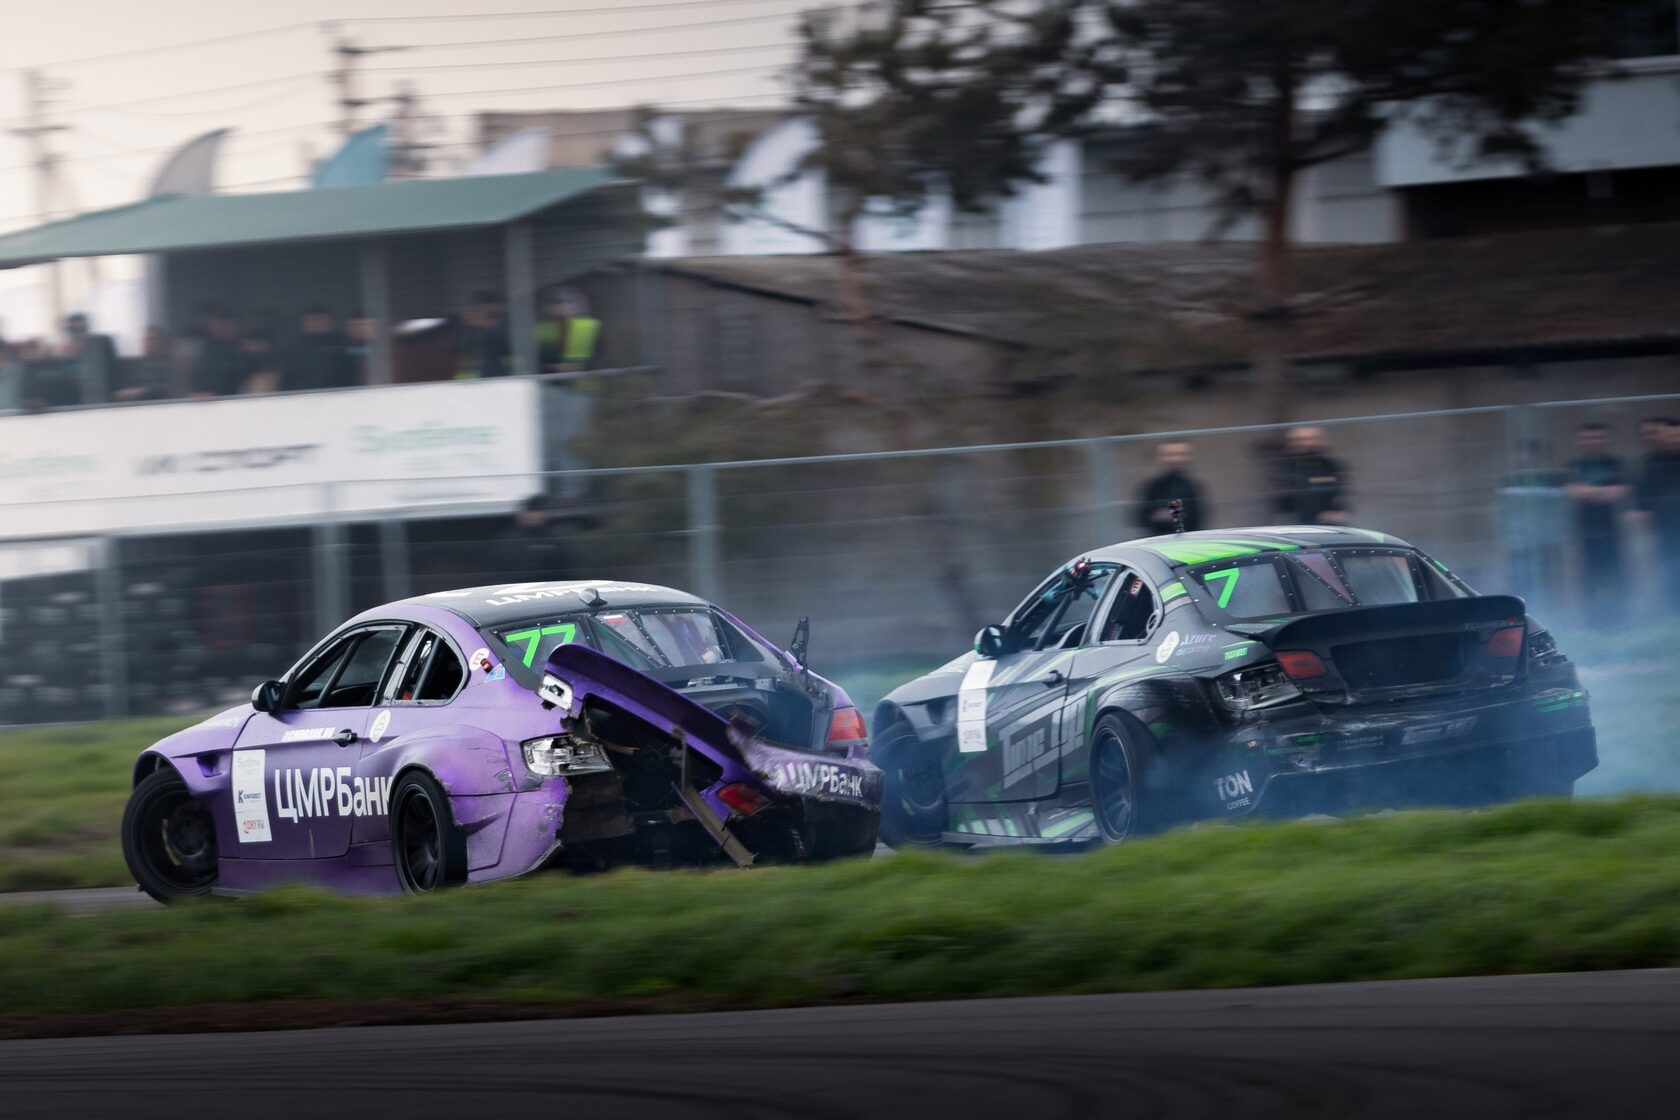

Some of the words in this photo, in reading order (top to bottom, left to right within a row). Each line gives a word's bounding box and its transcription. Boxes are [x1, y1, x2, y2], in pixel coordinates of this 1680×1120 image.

[1204, 567, 1240, 609] 7
[506, 624, 576, 669] 77
[1180, 633, 1217, 646] Azure
[1213, 769, 1254, 801] TON
[1227, 797, 1251, 810] COFFEE
